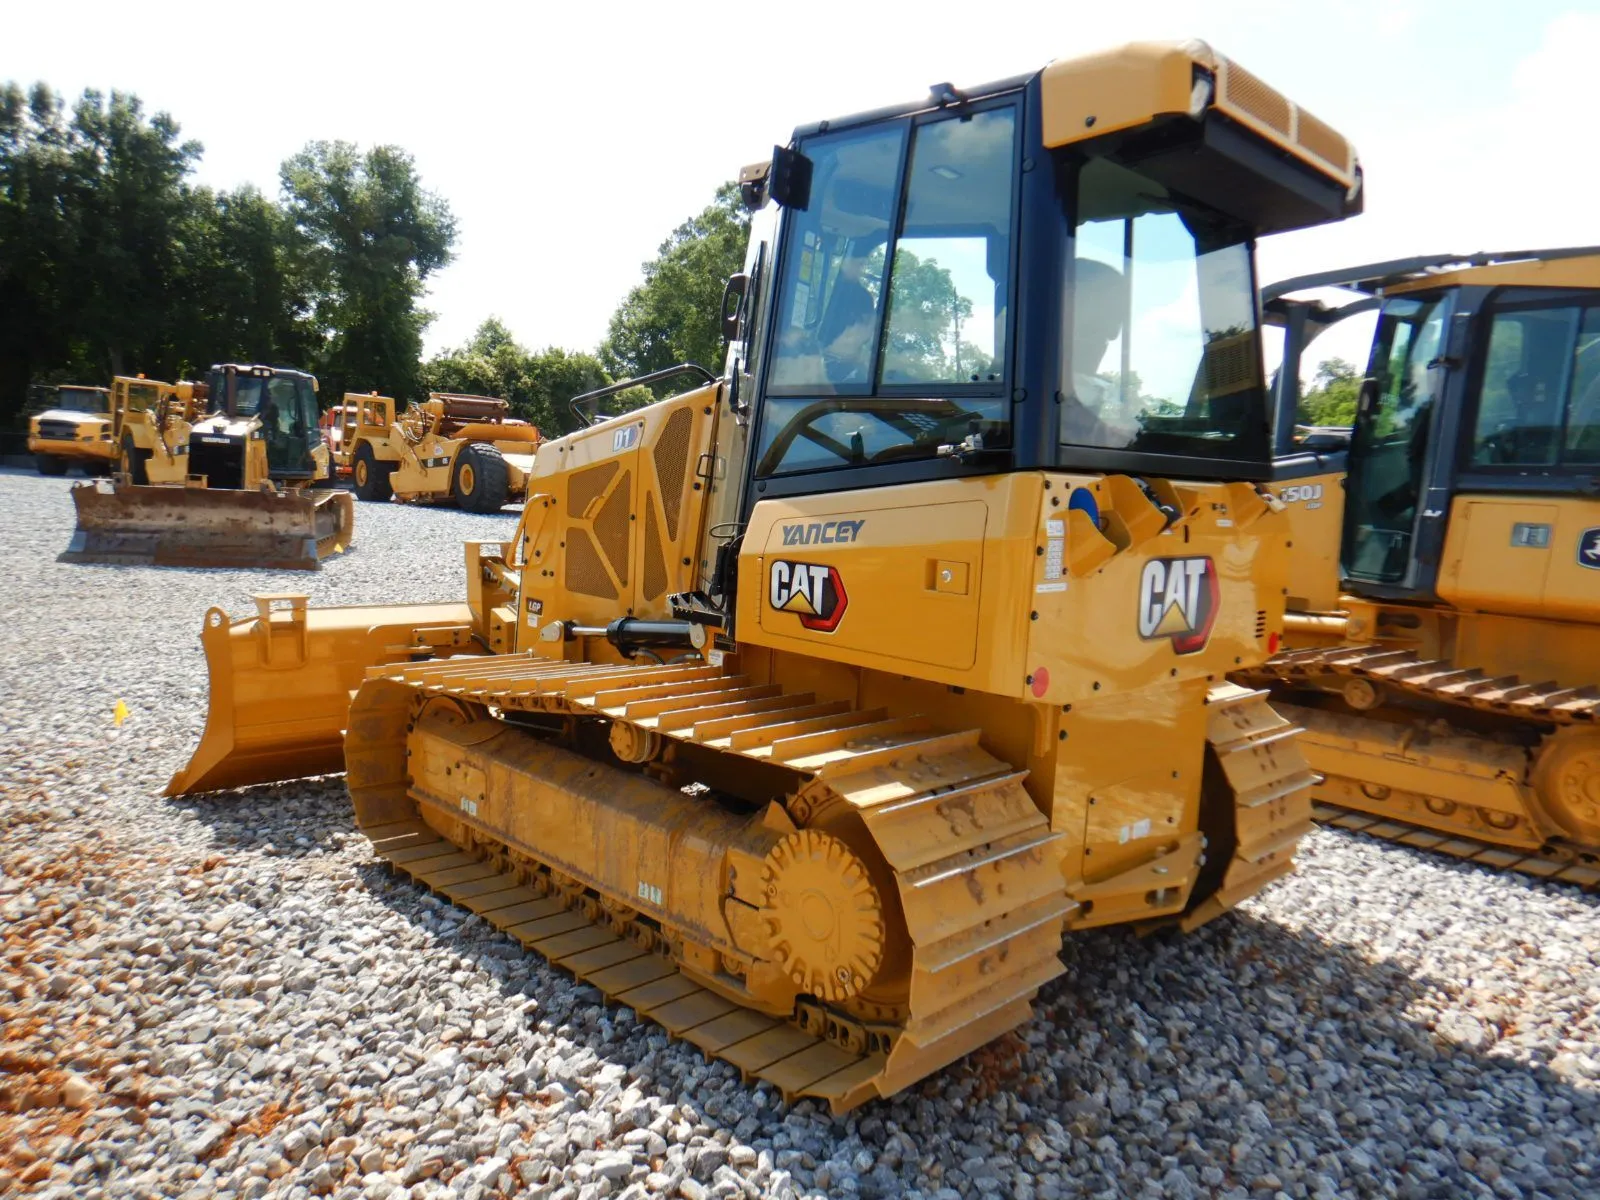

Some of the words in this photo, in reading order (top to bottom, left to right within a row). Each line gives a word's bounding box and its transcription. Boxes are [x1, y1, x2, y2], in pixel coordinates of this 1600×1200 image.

[613, 428, 631, 452] D1
[783, 520, 865, 545] YANCEY
[771, 561, 828, 614] CAT
[1140, 560, 1206, 638] CAT
